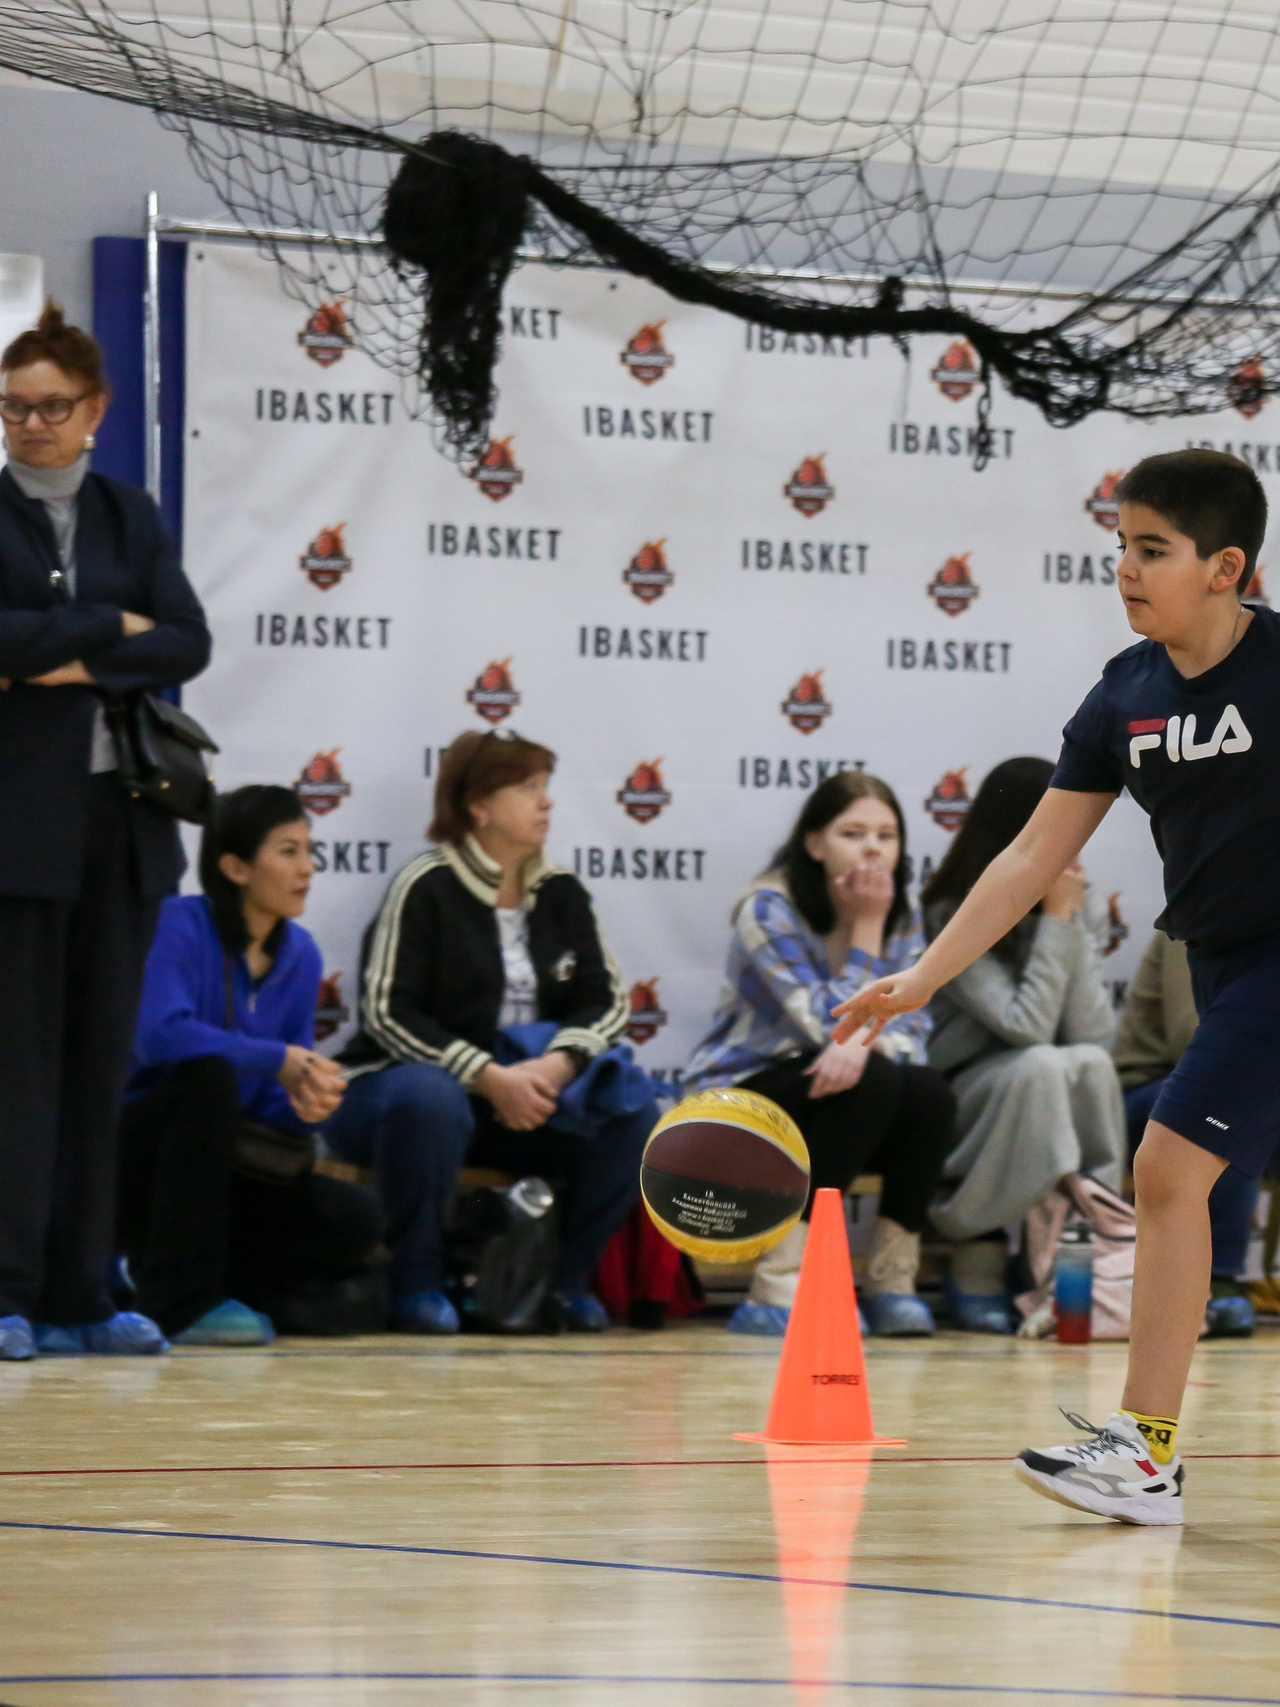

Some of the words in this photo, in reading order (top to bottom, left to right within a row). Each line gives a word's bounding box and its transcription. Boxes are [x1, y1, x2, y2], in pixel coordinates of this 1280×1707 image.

[255, 388, 394, 425] IBASKET
[583, 406, 714, 443] IBASKET
[428, 524, 561, 560] IBASKET
[742, 539, 869, 575] IBASKET
[1044, 553, 1116, 586] IBAS
[255, 613, 391, 649] IBASKET
[579, 626, 709, 662] IBASKET
[887, 639, 1012, 673] IBASKET
[1128, 704, 1253, 768] FILA
[313, 841, 391, 873] SKET
[574, 847, 706, 882] IBASKET
[811, 1374, 860, 1386] TORRES
